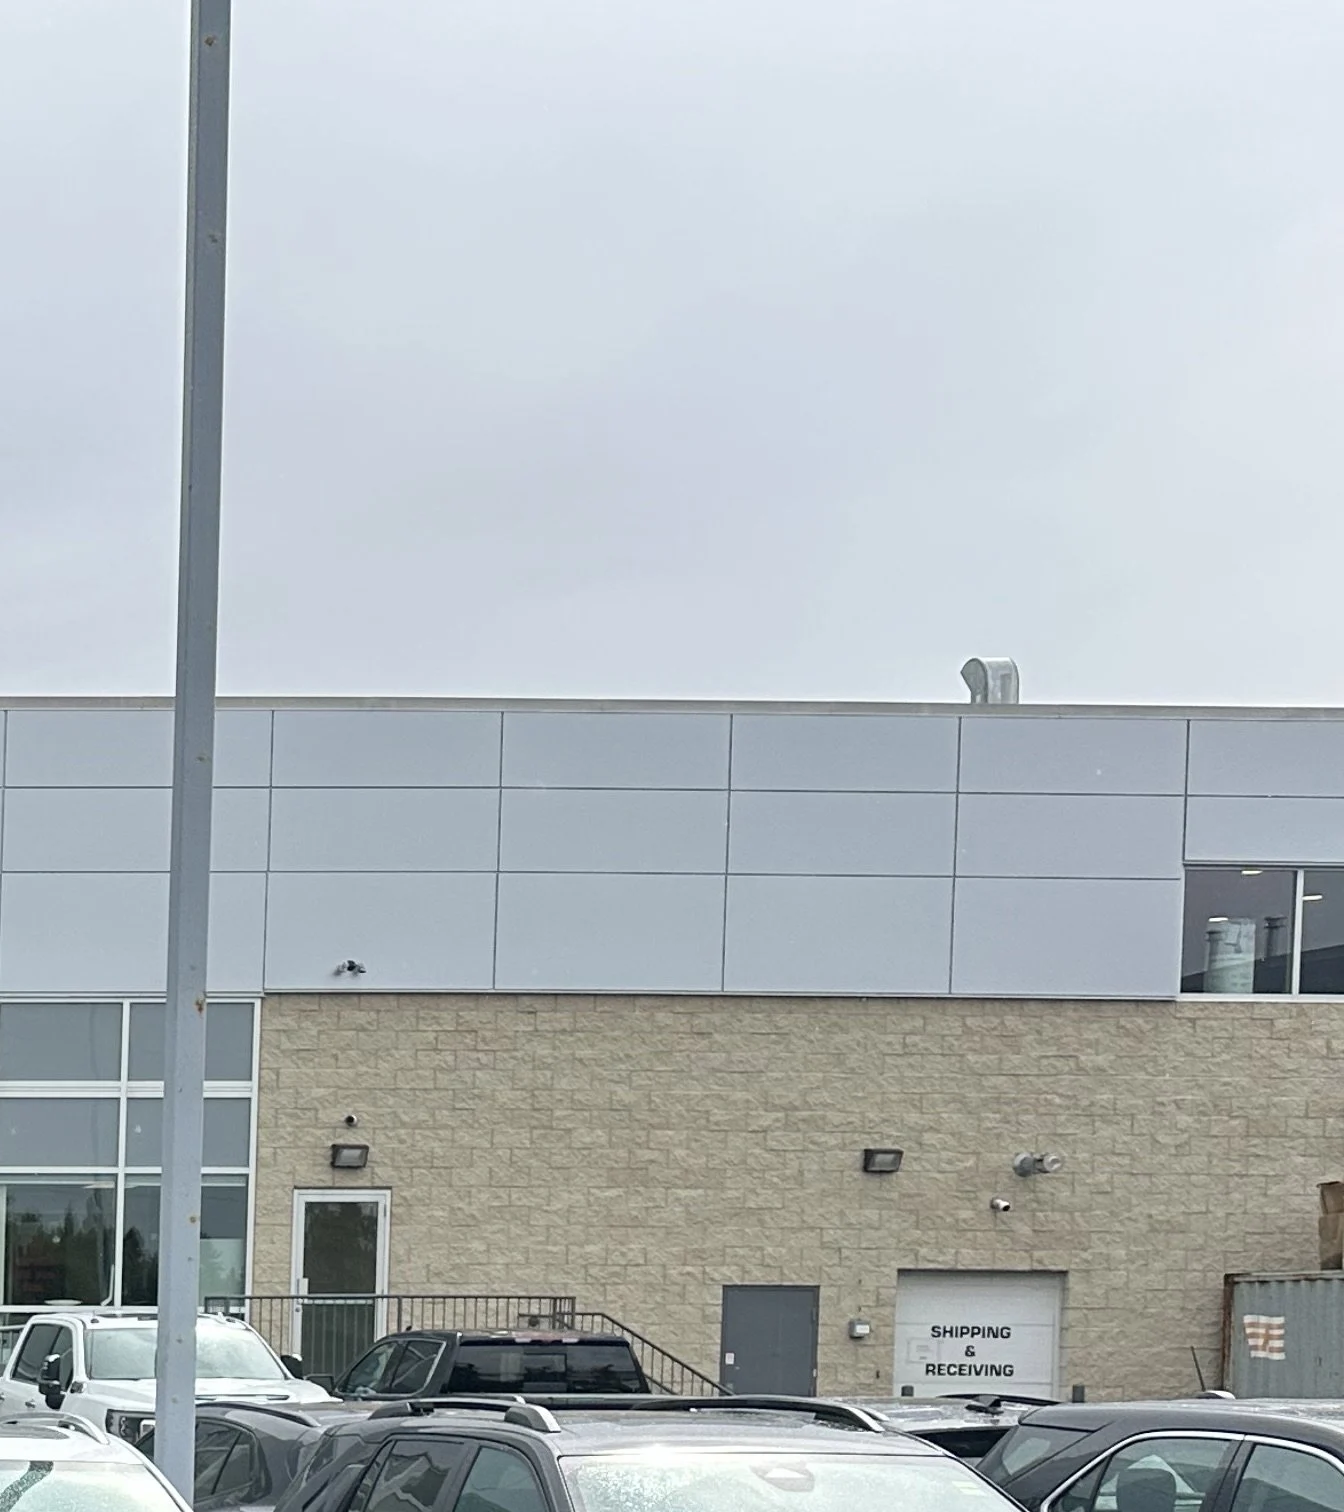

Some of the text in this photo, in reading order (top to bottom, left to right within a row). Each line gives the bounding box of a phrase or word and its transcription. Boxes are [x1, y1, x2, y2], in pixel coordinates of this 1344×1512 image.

[930, 1325, 1012, 1339] SHIPPING
[964, 1345, 976, 1357] &
[925, 1363, 1014, 1377] RECEIVING
